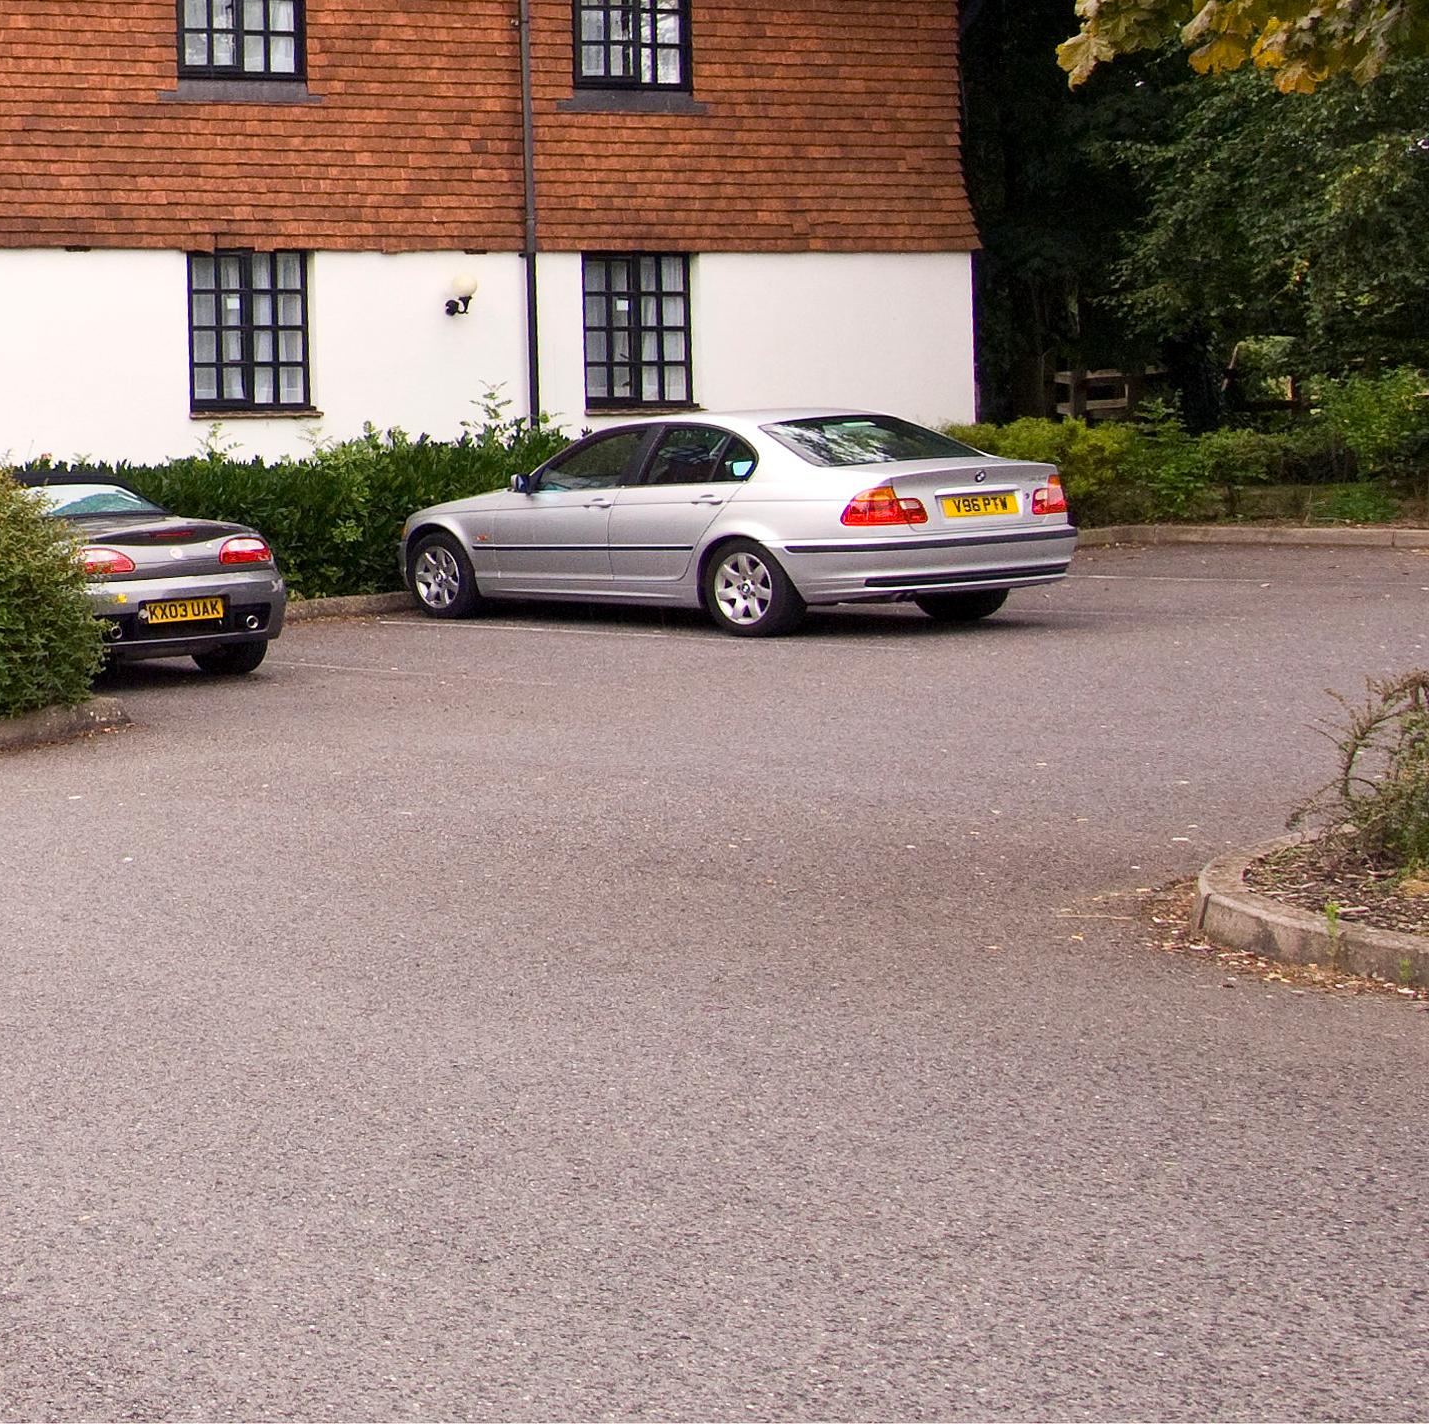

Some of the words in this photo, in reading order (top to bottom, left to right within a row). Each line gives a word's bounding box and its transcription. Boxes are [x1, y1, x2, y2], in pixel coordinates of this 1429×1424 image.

[952, 498, 981, 513] V96
[983, 497, 1008, 512] PTW
[148, 603, 188, 621] KX03
[191, 600, 220, 617] UAK
